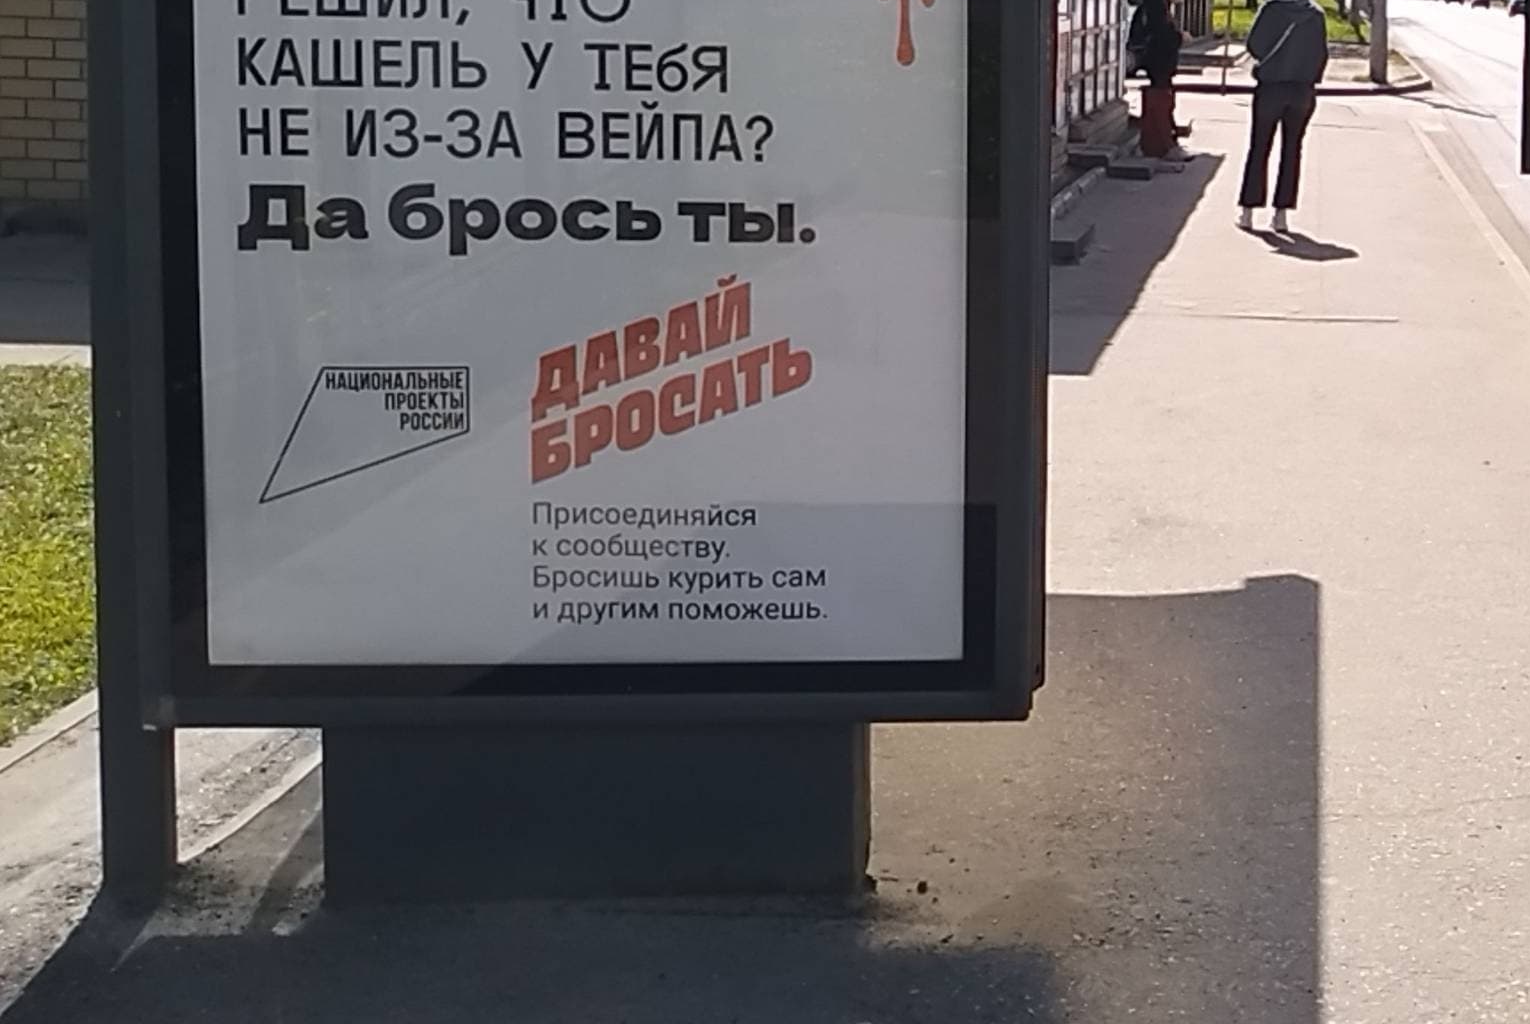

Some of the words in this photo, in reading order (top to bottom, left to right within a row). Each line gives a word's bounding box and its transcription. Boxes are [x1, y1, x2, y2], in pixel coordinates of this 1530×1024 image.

[237, 37, 488, 89] КАШЕЛЬ
[523, 42, 554, 91] У
[238, 107, 310, 157] НЕ
[345, 109, 521, 159] ИЗ-ЗА
[559, 102, 774, 164] ВЕЙПА?
[237, 184, 369, 252] Да
[388, 183, 663, 255] брось
[679, 202, 815, 245] ты.
[530, 273, 753, 424] ДАВАЙ
[324, 370, 464, 393] НАЦИОНАЛЬНЫЕ
[383, 392, 464, 411] ПРОЕКТЫ
[530, 337, 813, 485] БРОСАТЬ
[400, 410, 464, 432] РОССИИ
[532, 503, 757, 528] Присоединяйся
[532, 539, 548, 557] к
[556, 536, 731, 563] сообществу.
[532, 565, 660, 591] Бросишь
[668, 570, 765, 595] курить
[771, 569, 827, 588] сам
[532, 600, 549, 619] и
[556, 598, 659, 626] другим
[668, 599, 828, 622] поможешь.
